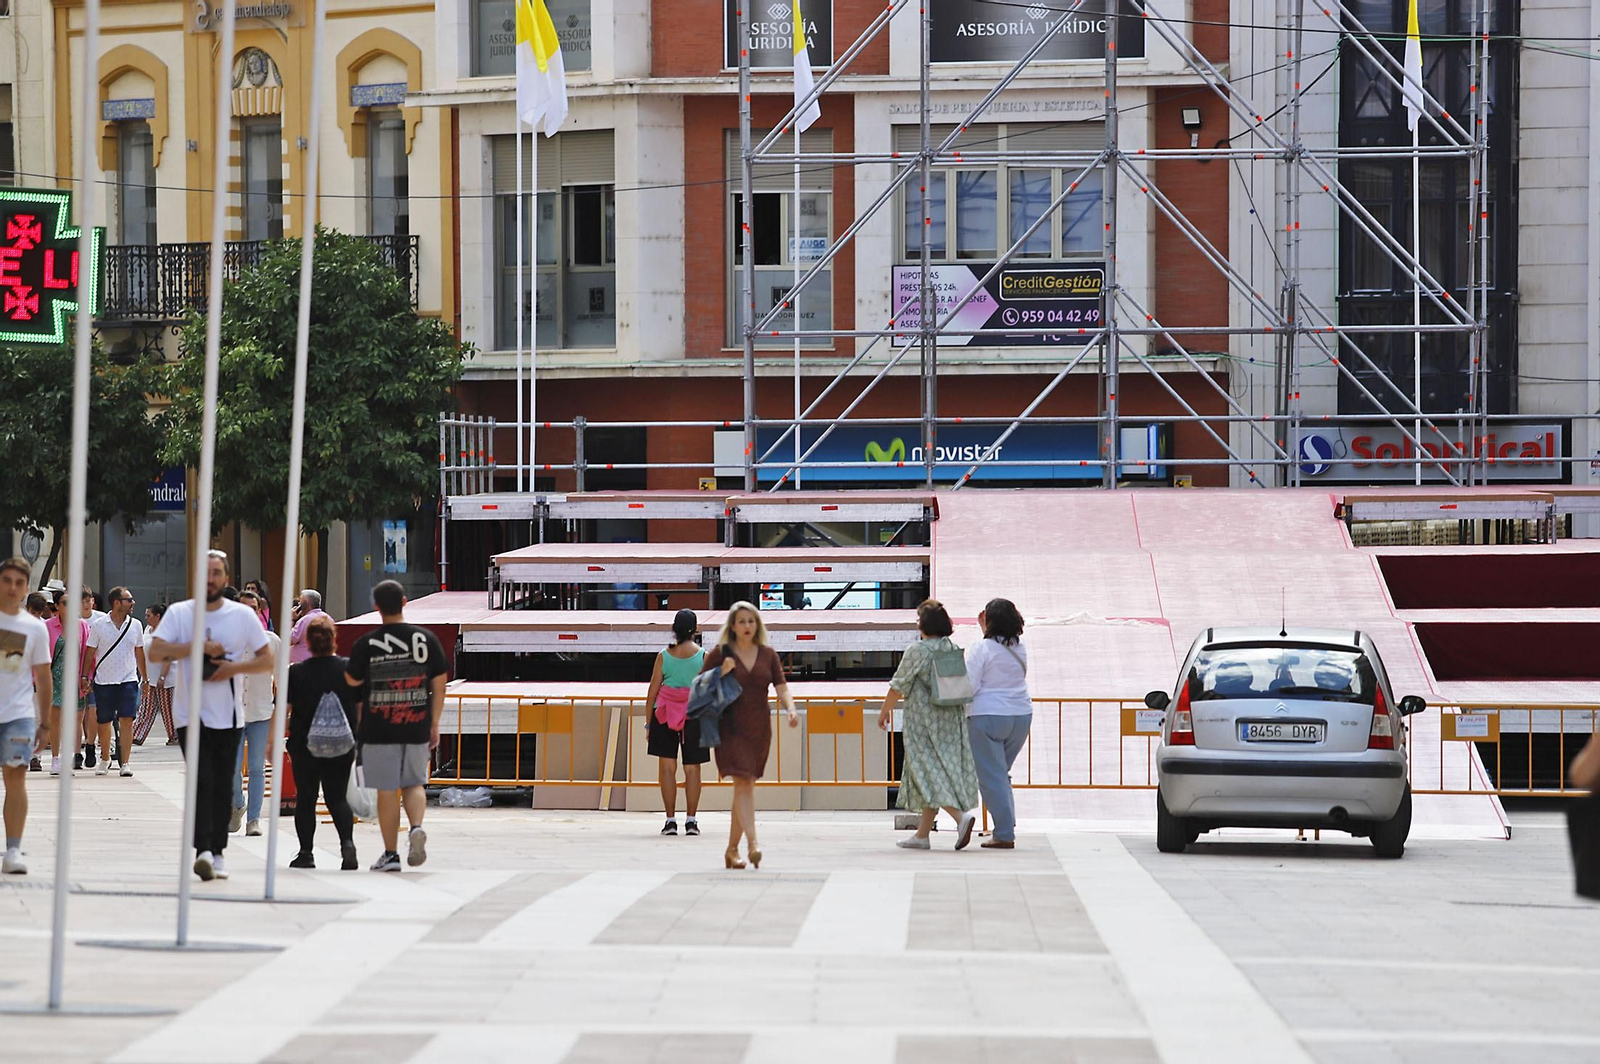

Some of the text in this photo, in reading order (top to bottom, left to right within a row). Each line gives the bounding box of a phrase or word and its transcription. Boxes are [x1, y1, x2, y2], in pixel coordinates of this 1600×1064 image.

[750, 19, 818, 35] SESOÍA
[956, 19, 1107, 36] ASESORÍA JRÍDIC
[749, 36, 815, 49] URÍDIA
[889, 103, 922, 114] SALO
[951, 102, 1028, 115] PELQUERIA
[1032, 101, 1040, 111] Y
[900, 271, 939, 279] HIPOTAS
[1003, 275, 1101, 289] CreditGestión
[1022, 309, 1100, 322] 959 04 42 49
[411, 632, 428, 663] 6
[1250, 725, 1282, 738] 8456
[1292, 725, 1317, 738] DYR
